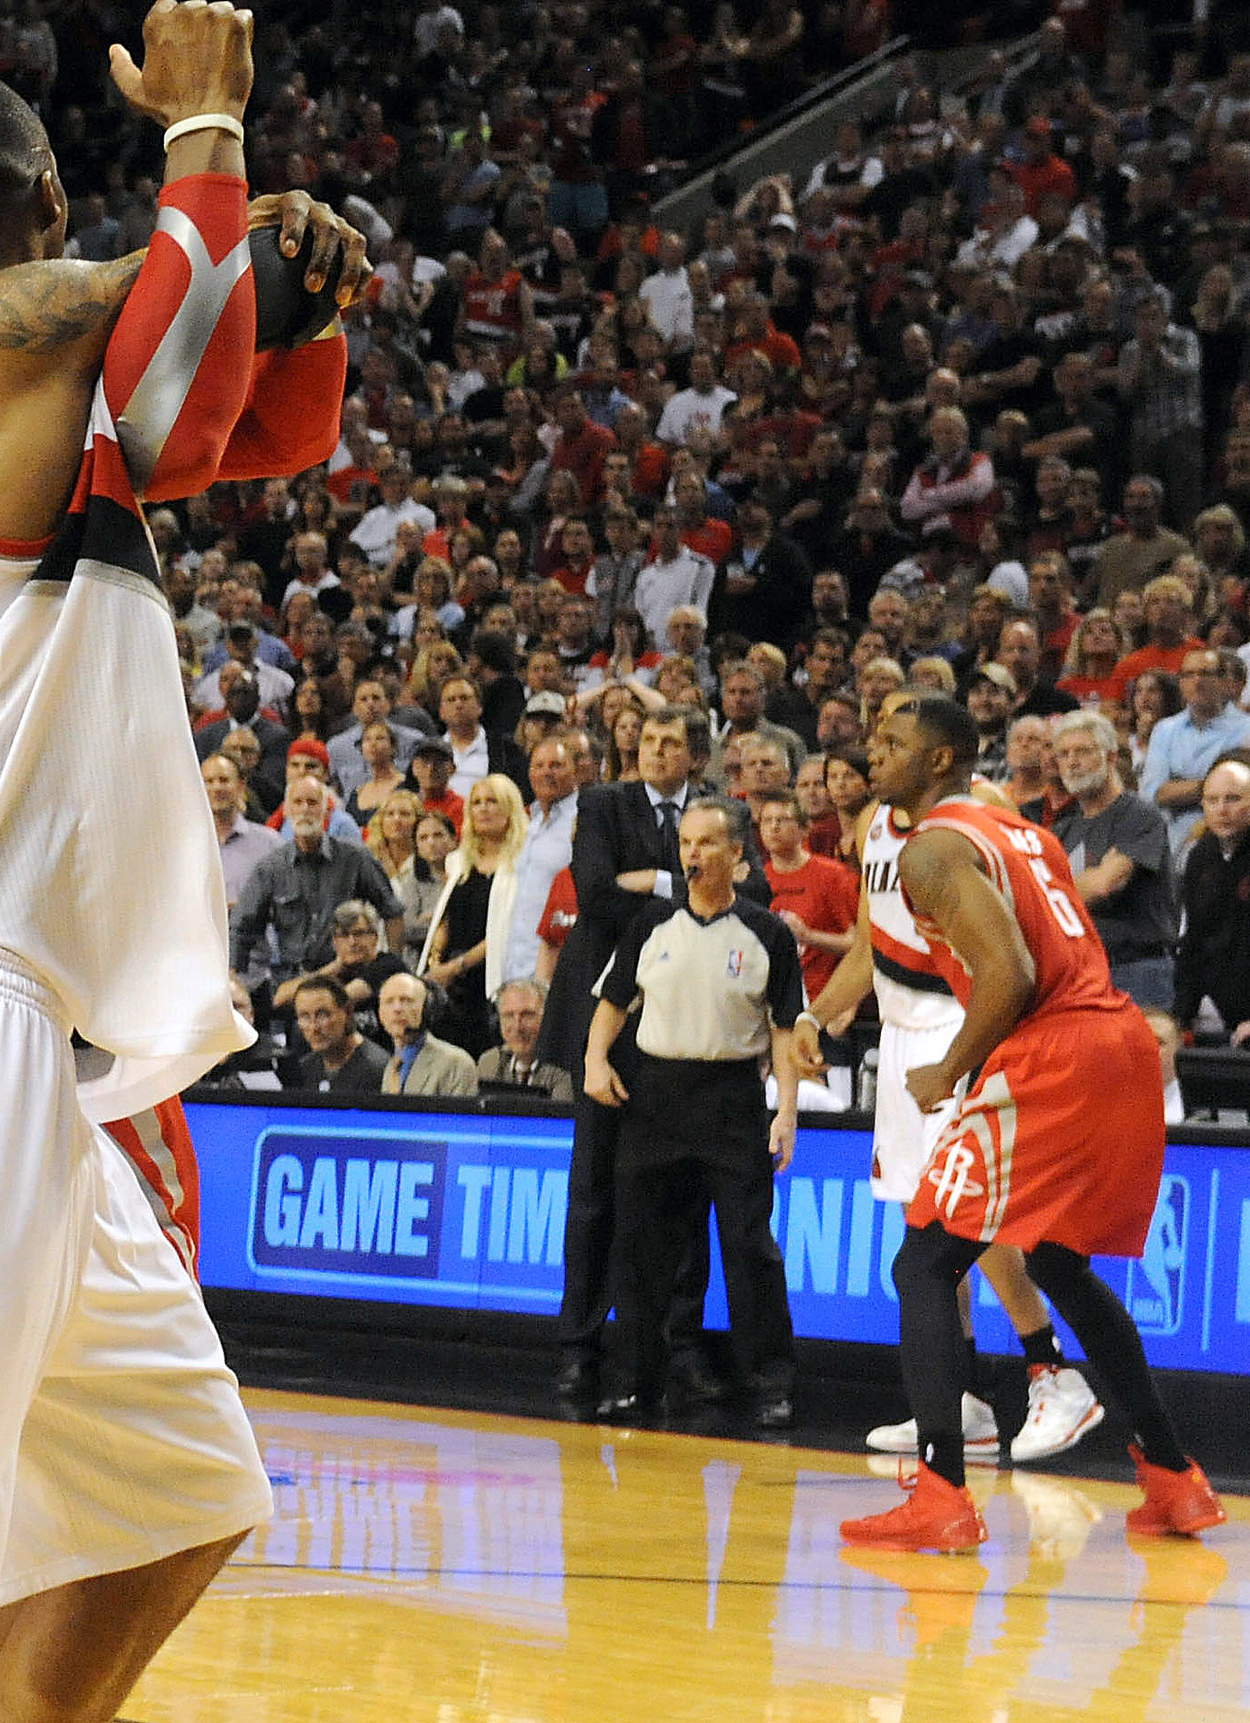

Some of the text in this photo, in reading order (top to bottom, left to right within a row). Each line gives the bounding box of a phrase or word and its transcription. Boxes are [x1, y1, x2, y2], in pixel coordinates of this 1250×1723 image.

[1028, 857, 1086, 938] 6
[263, 1153, 570, 1267] GAME TIM
